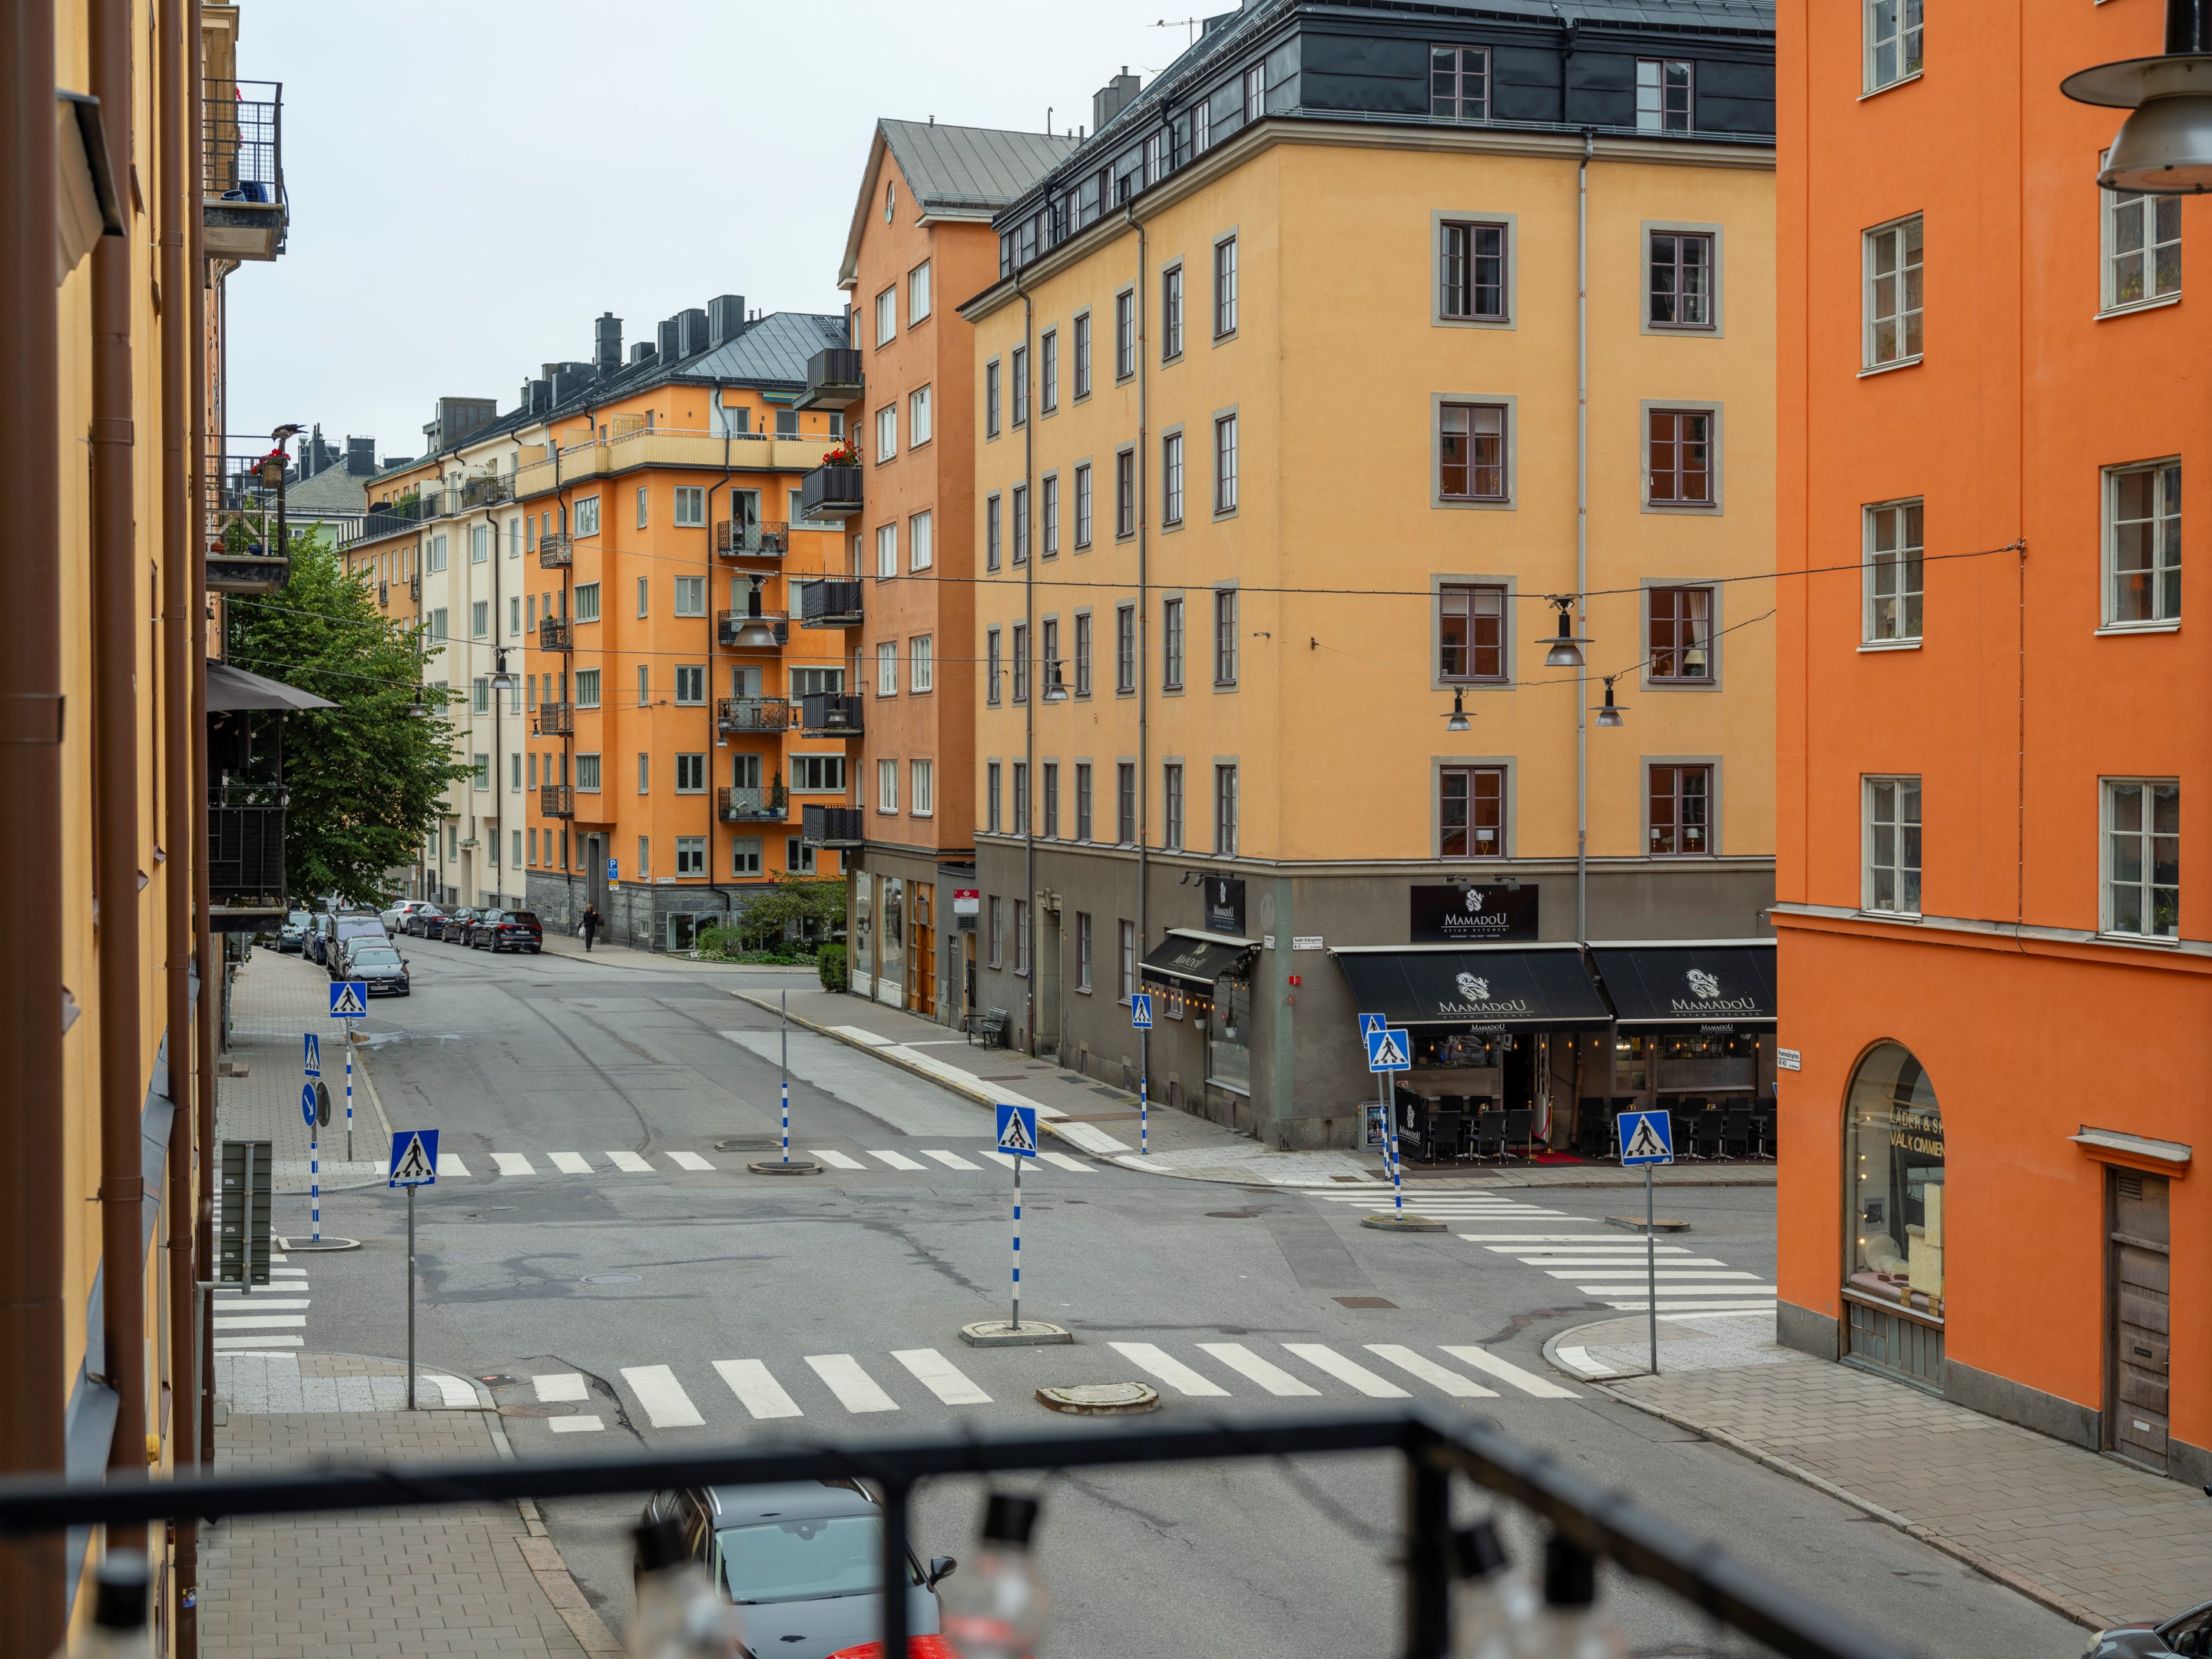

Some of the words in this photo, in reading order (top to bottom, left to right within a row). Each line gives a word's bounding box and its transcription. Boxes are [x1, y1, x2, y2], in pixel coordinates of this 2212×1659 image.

[1890, 1107, 1920, 1130] LÄDER
[1923, 1116, 1930, 1131] &
[1890, 1129, 1945, 1157] VÄLKOMMEN
